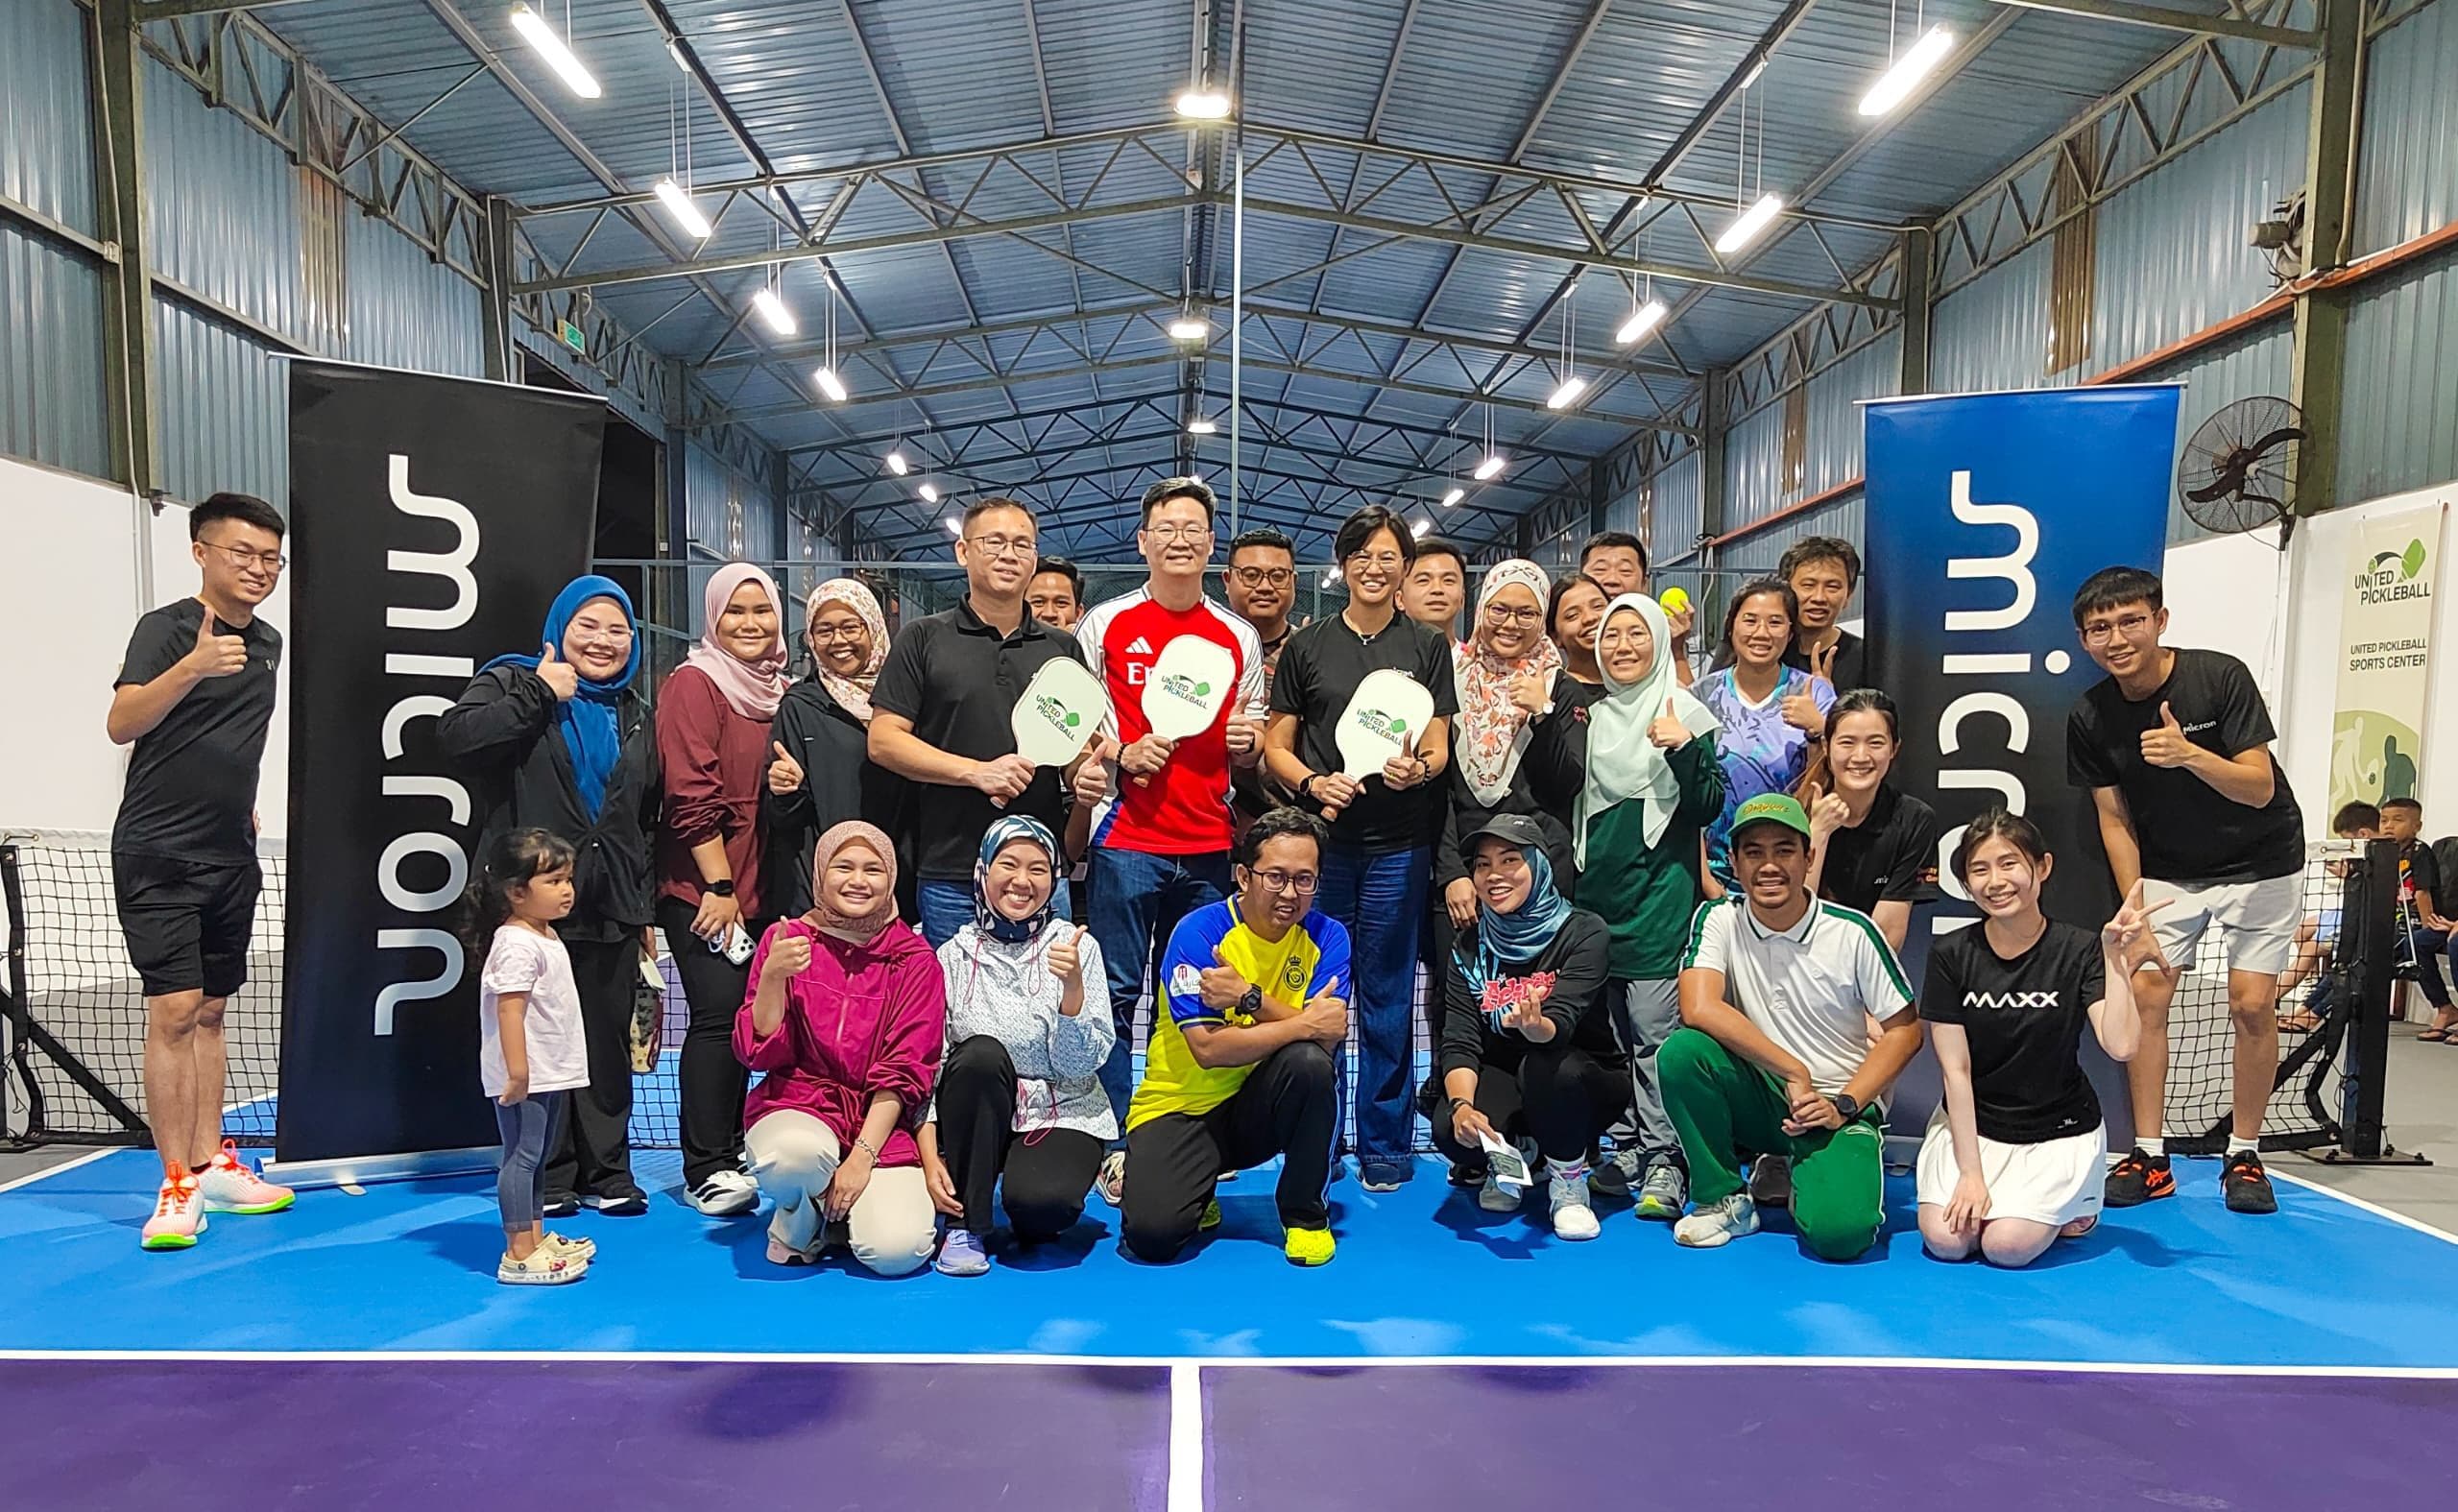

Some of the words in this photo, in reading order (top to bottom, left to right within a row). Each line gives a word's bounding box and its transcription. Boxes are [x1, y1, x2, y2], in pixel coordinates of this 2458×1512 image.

[2354, 570, 2395, 589] UNITED
[2361, 582, 2430, 606] PICKLEBALL
[2350, 643, 2377, 655] UNITED
[2378, 637, 2427, 653] PICKLEBALL
[2350, 657, 2385, 671] SPORTS
[2387, 654, 2426, 668] CENTER
[1161, 675, 1190, 692] UNITED
[1036, 694, 1061, 718] UNITED
[1163, 684, 1208, 709] PICKLEBALL
[1931, 470, 2070, 935] micr
[1036, 704, 1075, 742] PICKLEBALL
[1357, 708, 1386, 728] UNITED
[1358, 717, 1403, 747] PICKLEBALL
[1963, 991, 2059, 1008] MAXX
